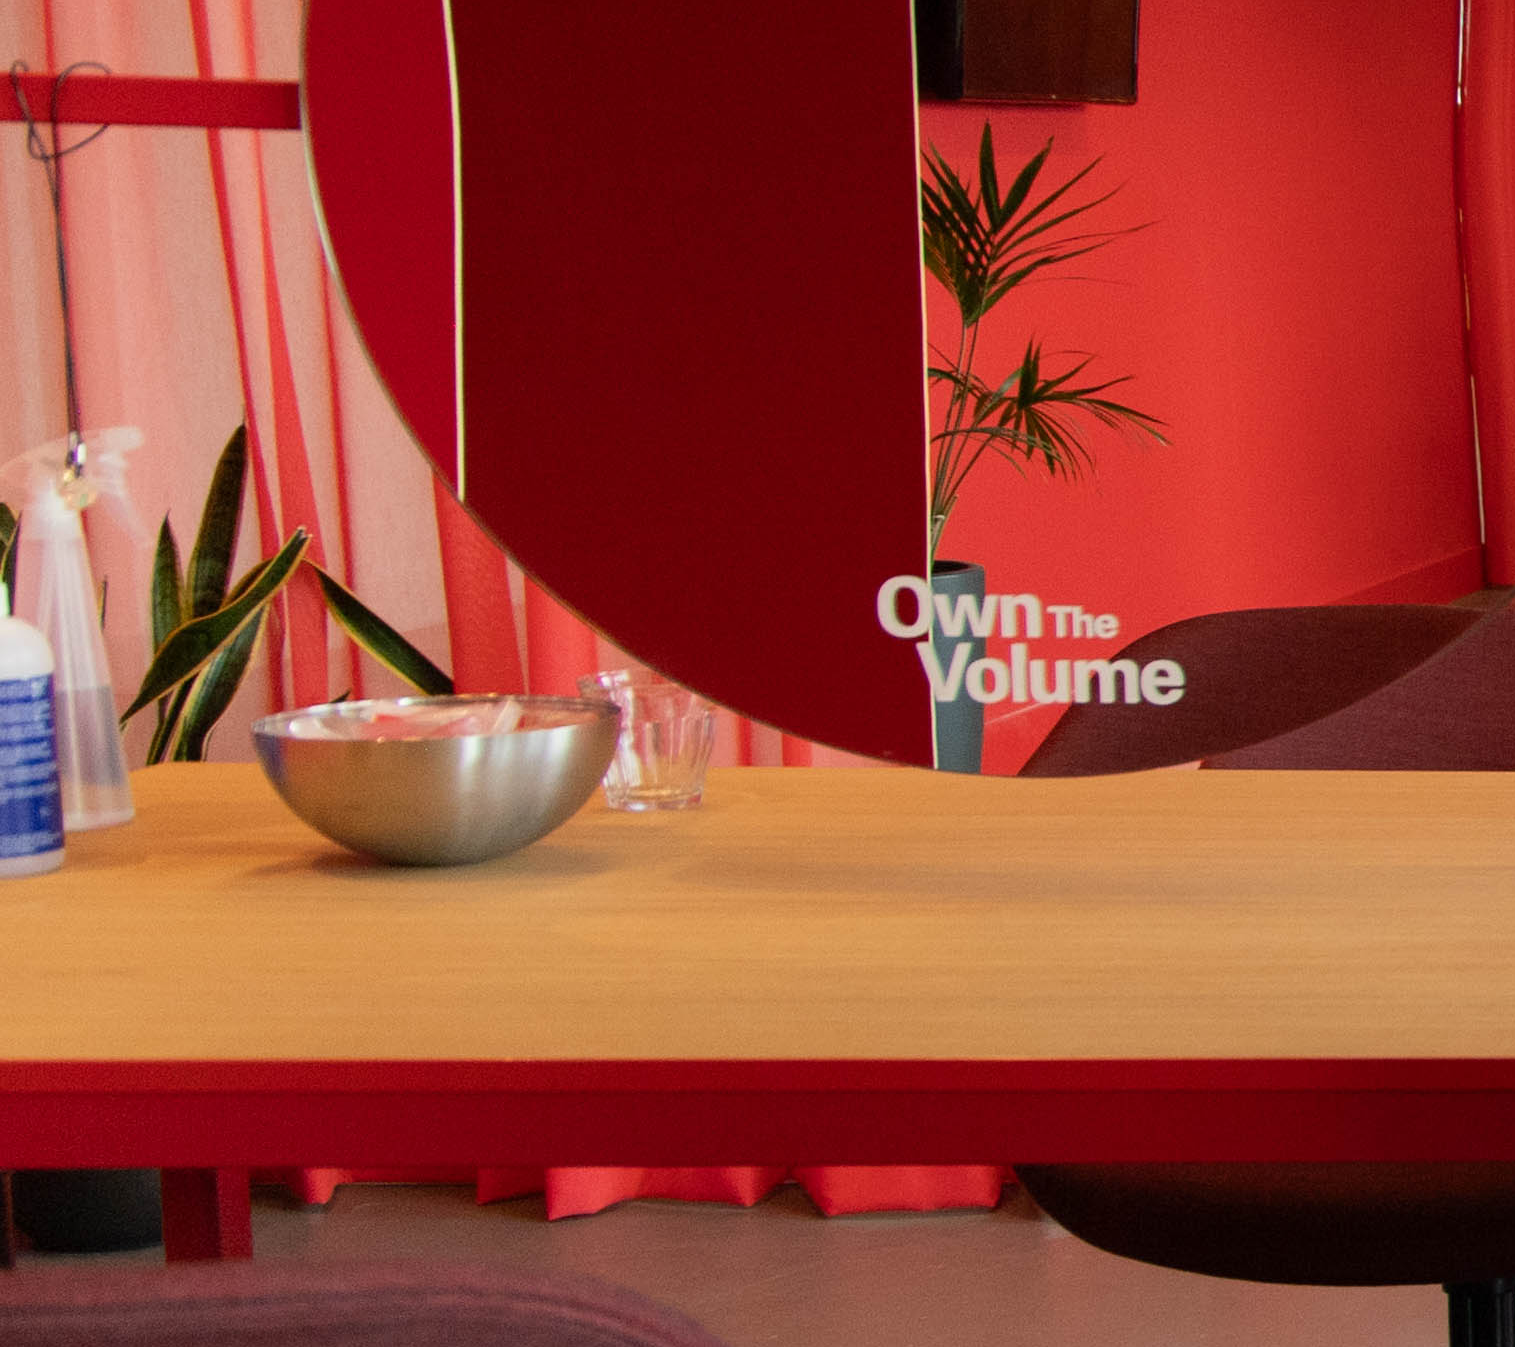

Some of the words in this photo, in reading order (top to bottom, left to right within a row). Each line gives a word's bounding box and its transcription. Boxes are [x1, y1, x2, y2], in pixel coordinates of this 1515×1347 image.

[876, 574, 1043, 639] Own
[1046, 605, 1120, 640] The
[915, 641, 1186, 706] Volume
